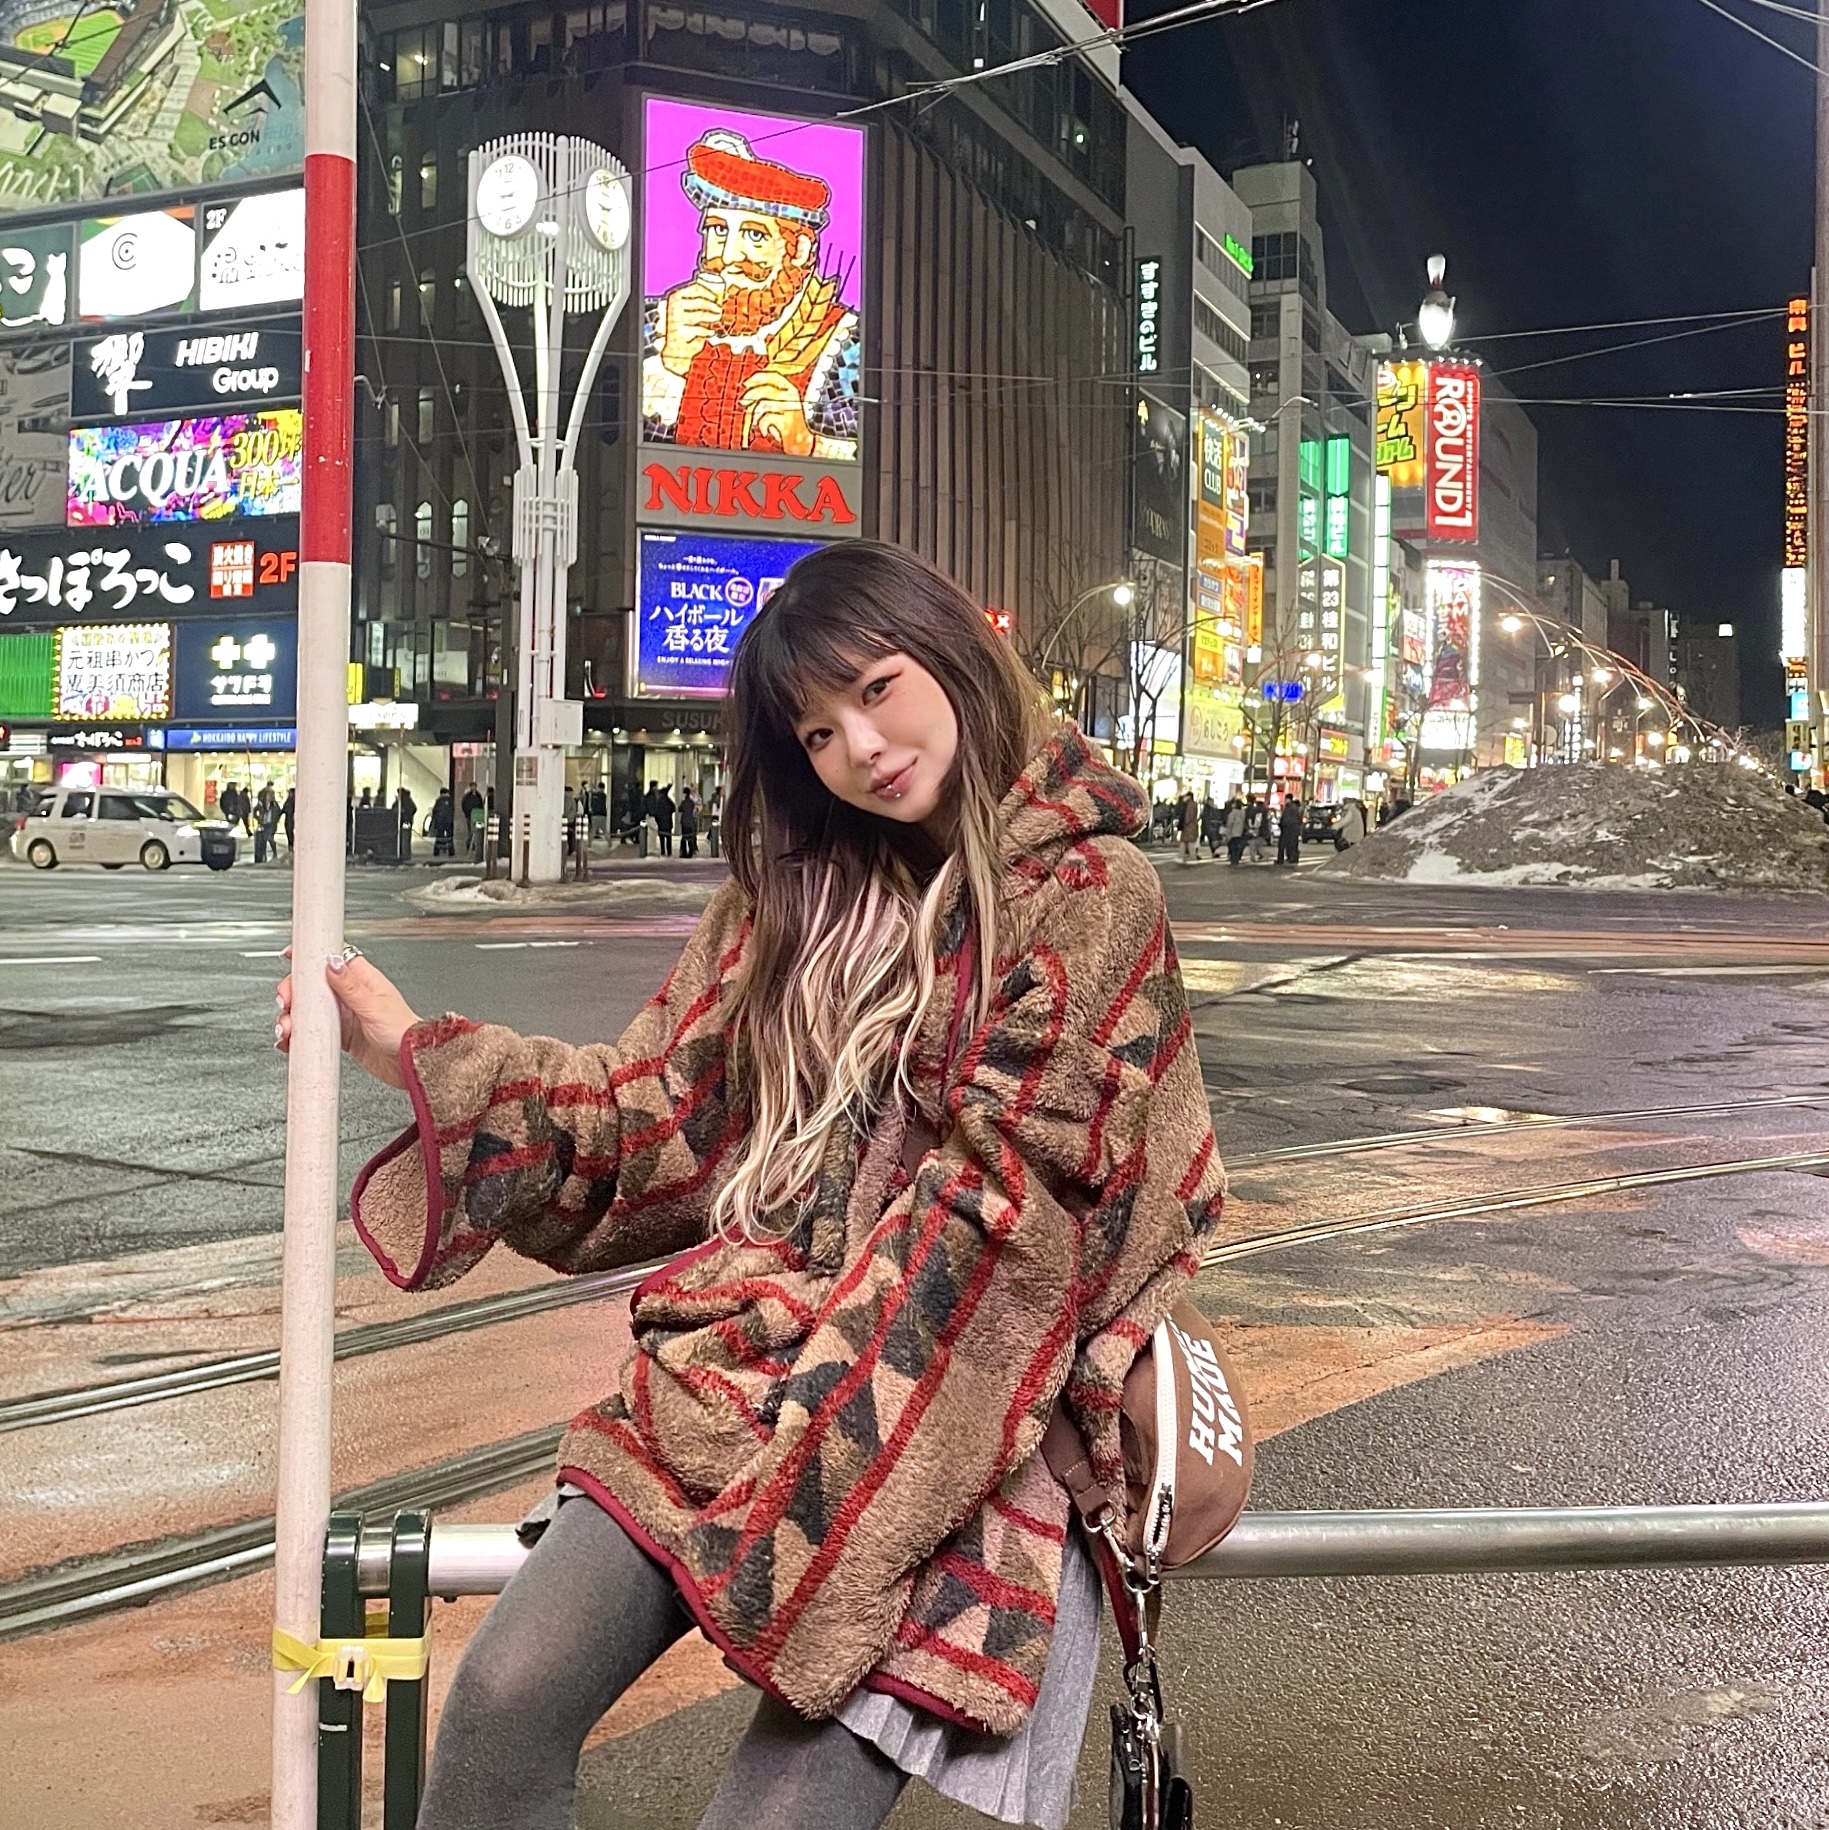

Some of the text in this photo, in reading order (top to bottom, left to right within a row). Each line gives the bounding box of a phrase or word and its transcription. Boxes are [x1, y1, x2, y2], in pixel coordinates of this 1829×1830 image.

[206, 208, 227, 230] 2F
[1139, 261, 1159, 371] すすきのビル
[175, 332, 259, 368] HIBIKI
[212, 366, 279, 394] Group
[1433, 376, 1473, 527] ROUND1
[79, 448, 230, 507] ACQUA
[1204, 468, 1222, 496] CLUB
[1464, 423, 1473, 511] ENTERTAINMENT
[237, 469, 301, 502] 日本一
[644, 465, 857, 523] NIKKA
[0, 542, 195, 615] さっぽろっこ
[260, 552, 297, 584] 2F
[670, 582, 724, 601] BLACK
[649, 602, 744, 627] ハイボール
[662, 624, 730, 653] 香る夜
[67, 649, 155, 670] 元祖串かつ
[656, 655, 679, 664] ENJOY
[680, 656, 685, 664] A
[685, 656, 712, 666] RELAXING
[202, 731, 291, 743] HOKKAIDO HAPPY LIFESTYLE
